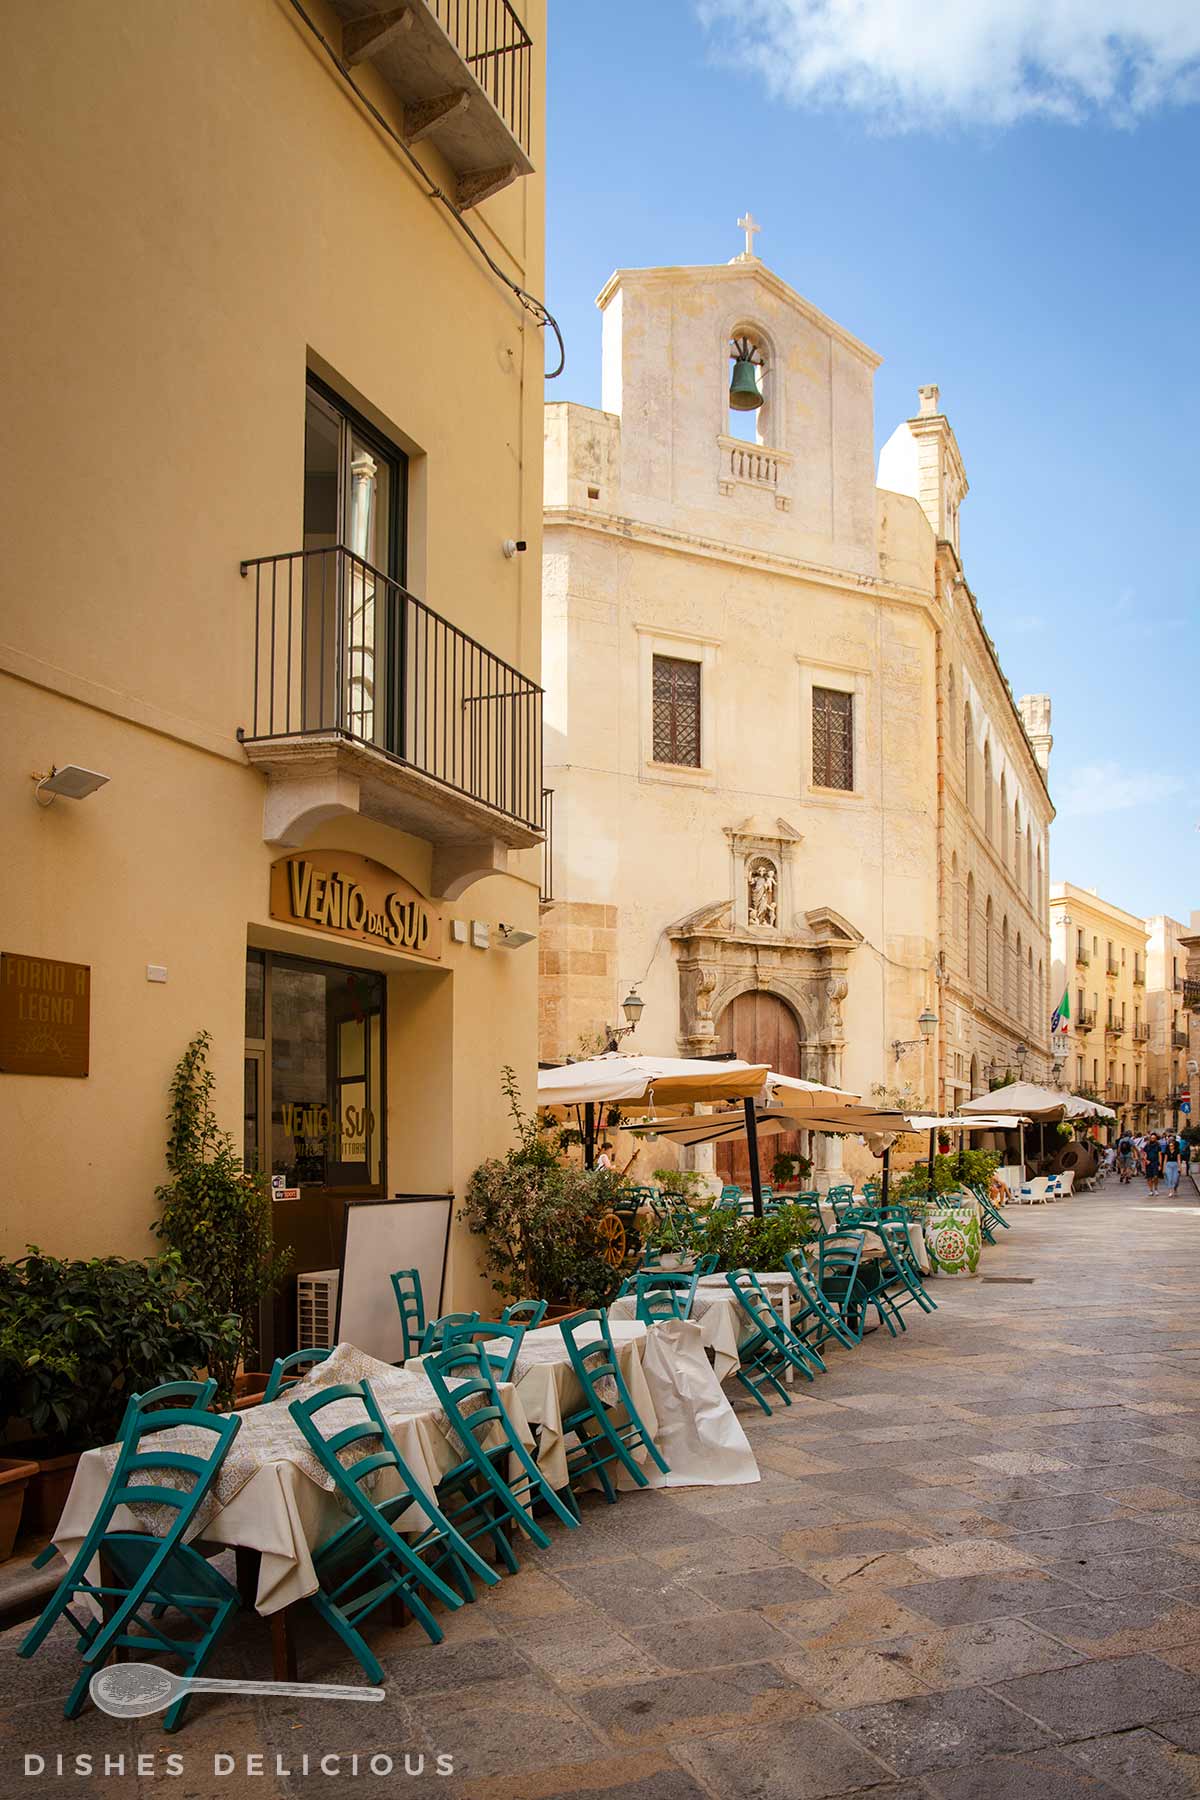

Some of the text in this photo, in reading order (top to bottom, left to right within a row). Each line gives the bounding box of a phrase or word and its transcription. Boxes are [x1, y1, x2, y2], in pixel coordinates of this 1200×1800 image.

[289, 860, 430, 950] VENTO DAL SUD
[7, 958, 86, 996] FORNO A
[19, 991, 74, 1025] LEGNA
[282, 1103, 330, 1137] VENTO
[345, 1105, 375, 1138] SUD
